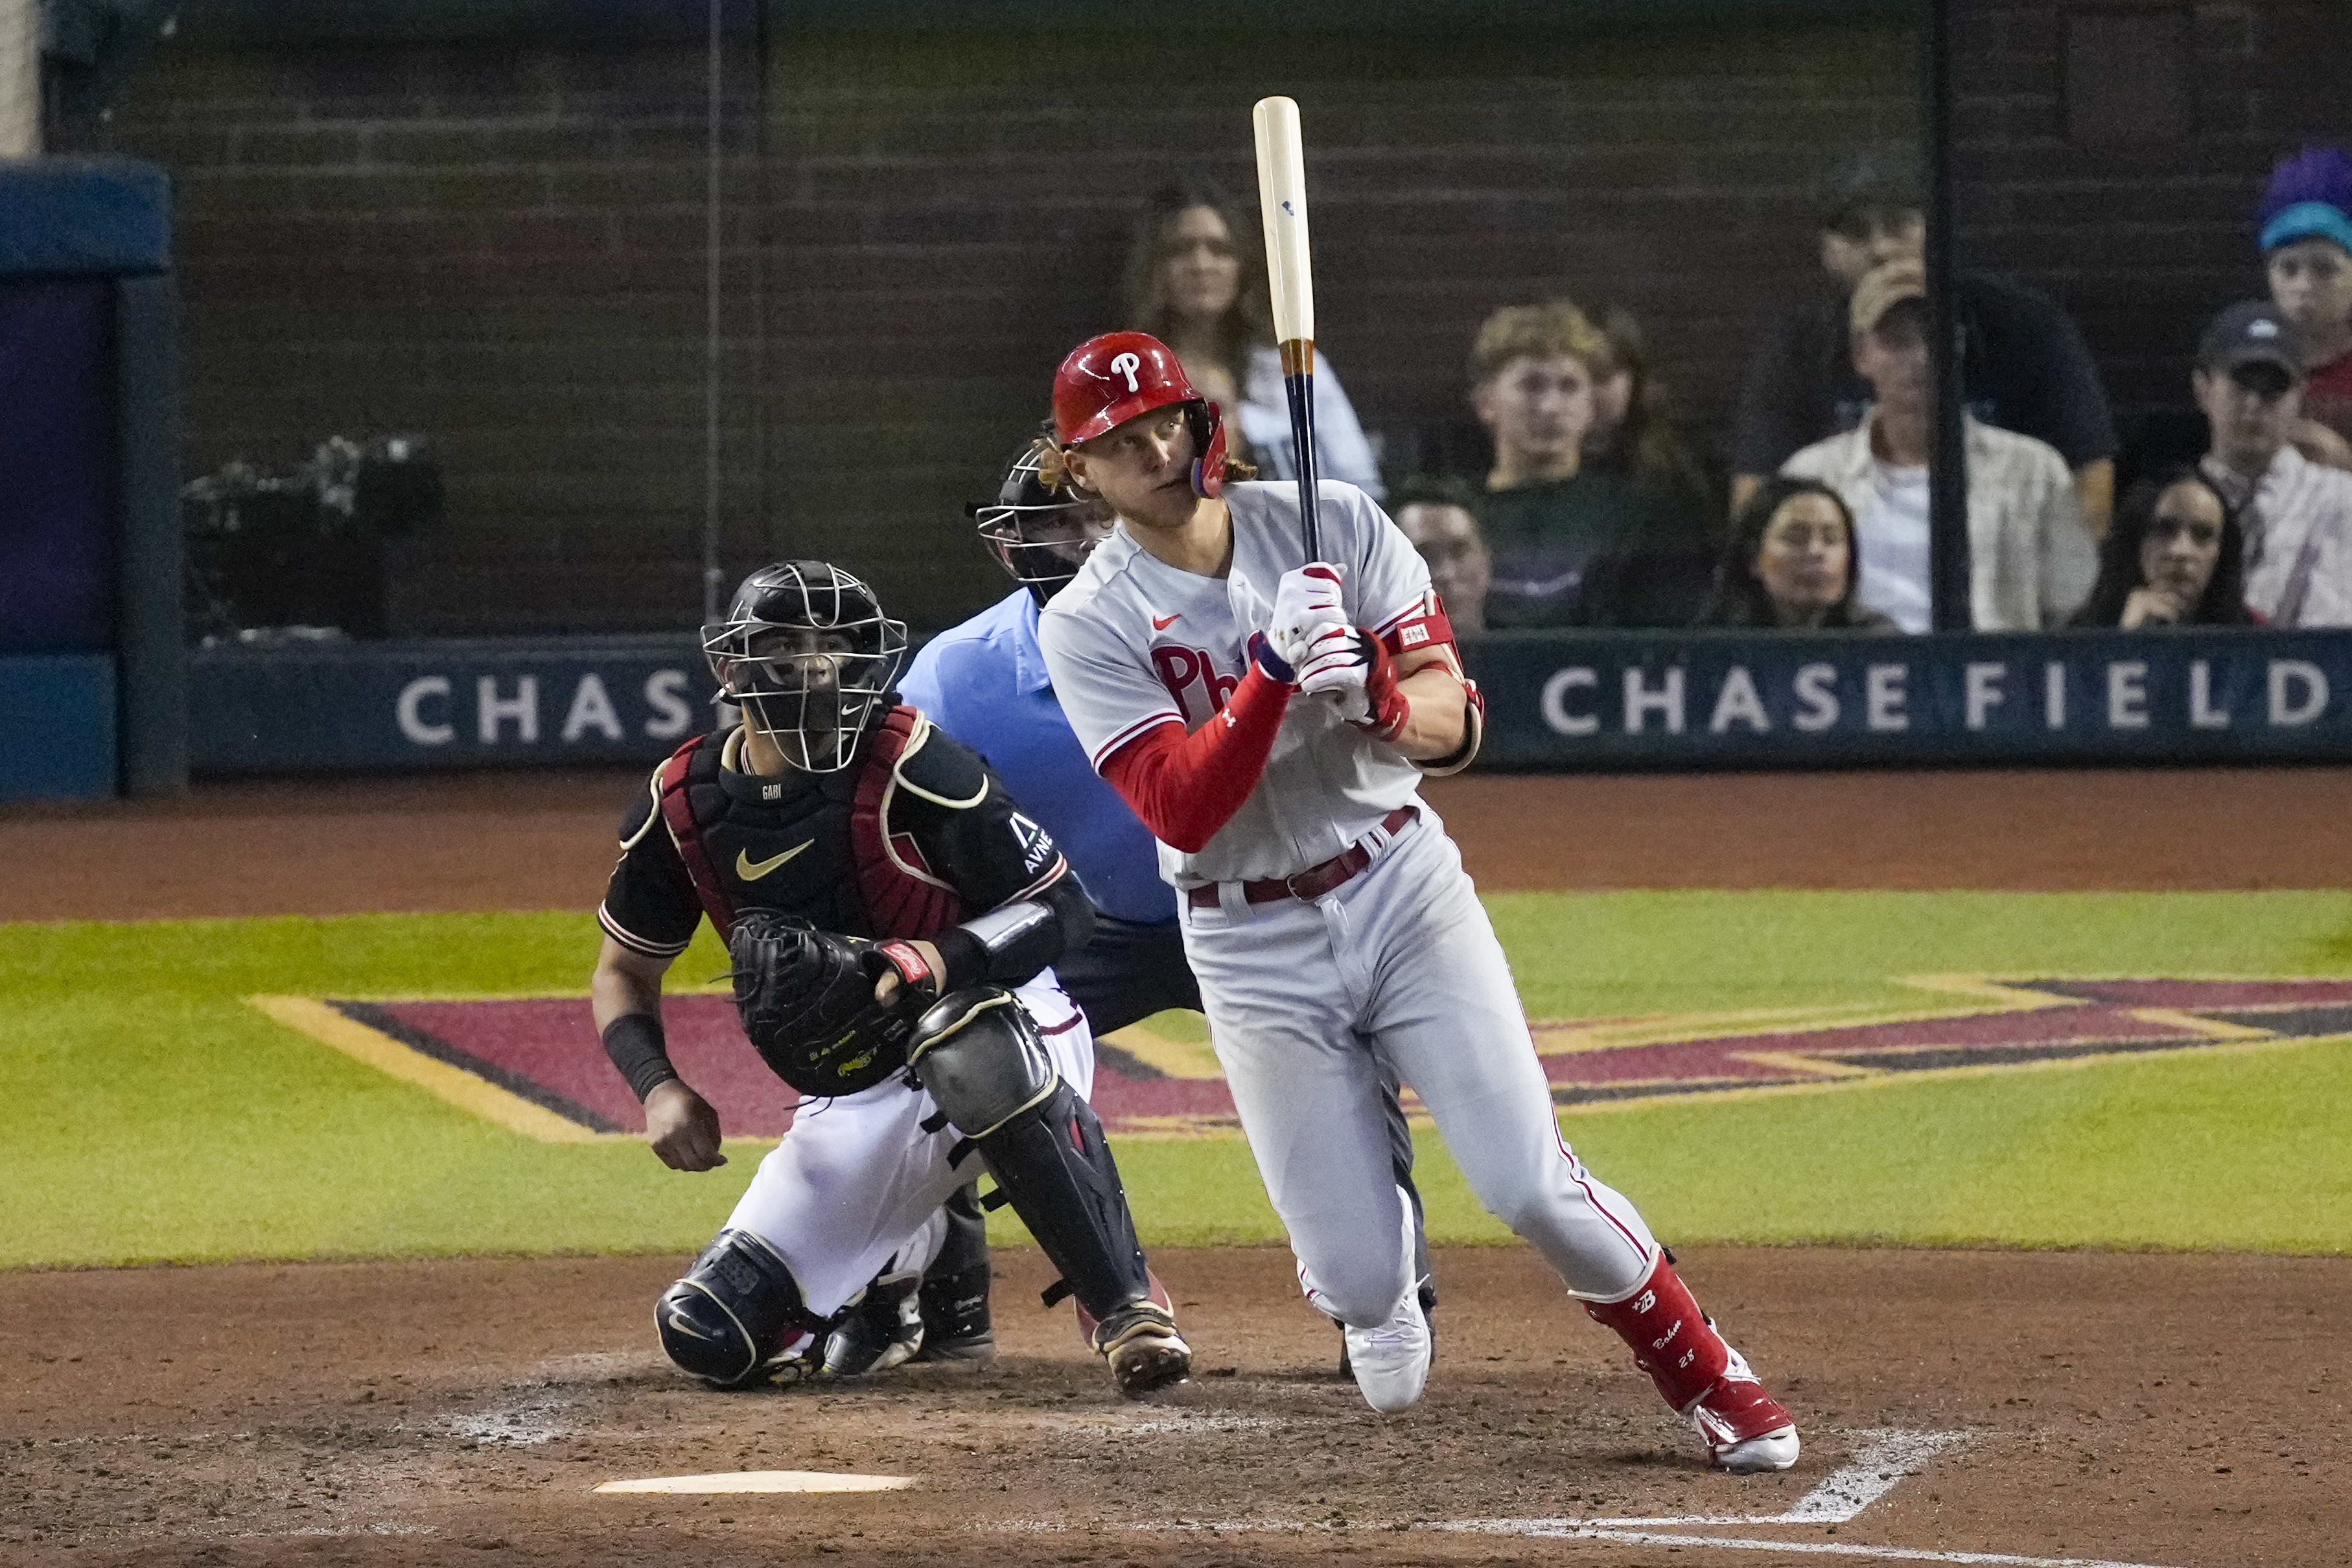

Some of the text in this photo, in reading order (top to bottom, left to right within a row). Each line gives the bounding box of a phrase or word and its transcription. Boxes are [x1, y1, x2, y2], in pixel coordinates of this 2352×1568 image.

[1111, 352, 1140, 393] P
[395, 669, 742, 745] CHAS
[1540, 658, 2331, 736] CHASE FIELD
[762, 783, 782, 800] GABI
[1024, 828, 1053, 874] AVNE
[1652, 1319, 1682, 1349] Bohm
[1679, 1348, 1695, 1368] 28
